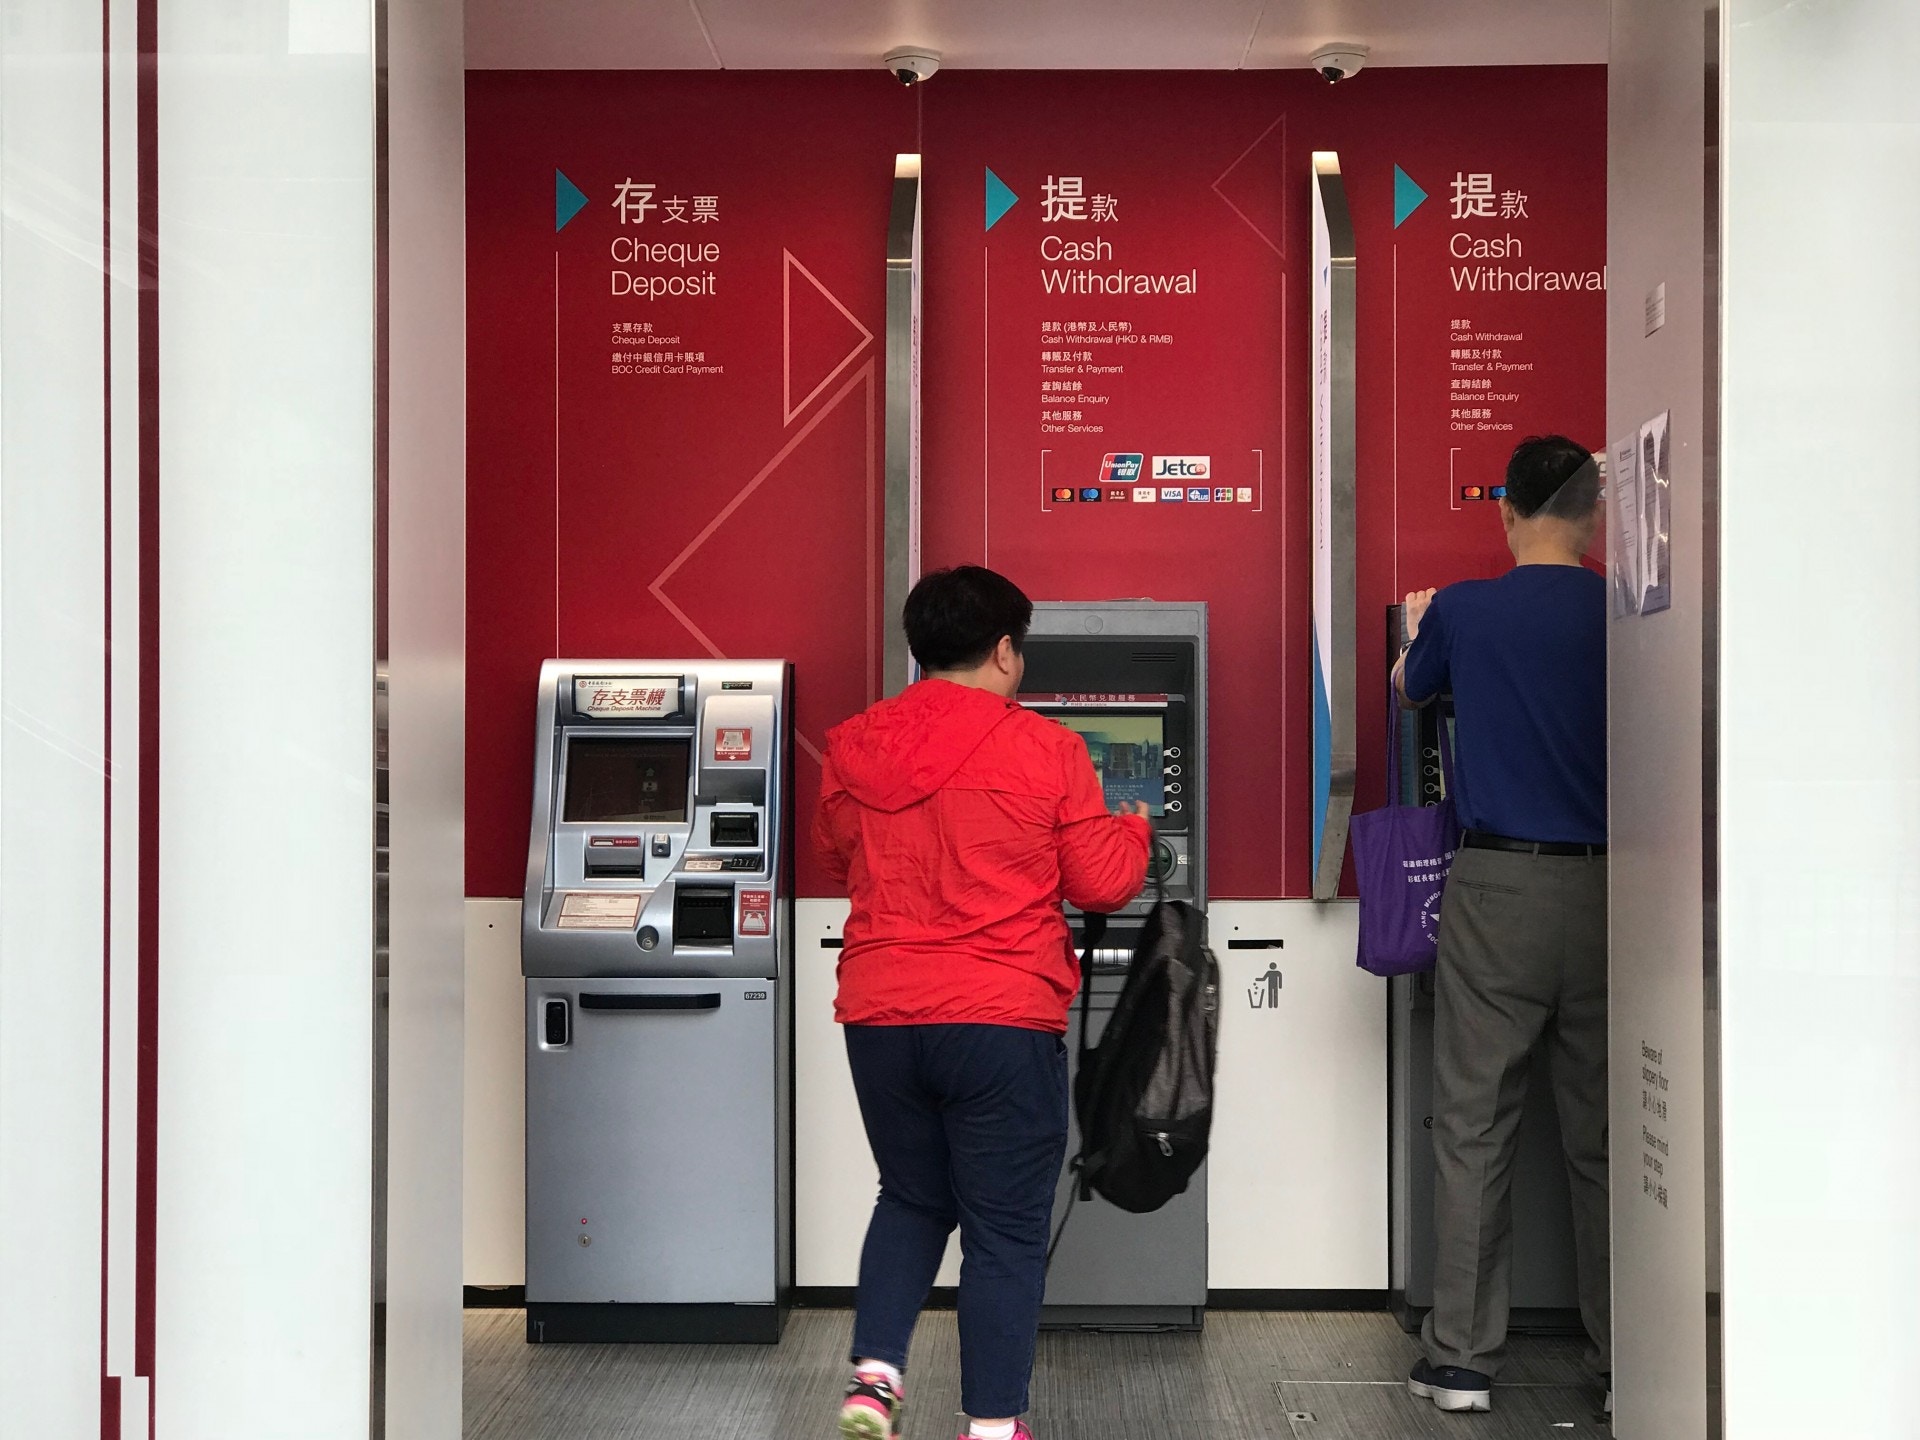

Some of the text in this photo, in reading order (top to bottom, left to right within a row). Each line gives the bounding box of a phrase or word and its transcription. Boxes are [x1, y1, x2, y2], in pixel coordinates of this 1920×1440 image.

[611, 177, 720, 224] 存支票
[1041, 175, 1118, 222] 提款
[1450, 172, 1528, 219] 提款
[1041, 236, 1111, 261] Cash
[1450, 233, 1521, 258] Cash
[611, 237, 719, 267] Cheque
[1041, 269, 1196, 294] Withdrawal
[1450, 266, 1606, 291] Withdrawal
[612, 271, 716, 301] Deposit
[613, 323, 653, 333] 支票存款
[1042, 322, 1061, 331] 提款
[1451, 319, 1470, 329] 提款
[612, 336, 680, 345] Cheque Deposit
[1042, 335, 1173, 344] Cash Withdrawal (HKD & RMB)
[1451, 333, 1522, 341] Cash Withdrawal
[612, 365, 723, 375] BOC Credit Card Payment
[1041, 365, 1123, 374] Transfer & Payment
[1451, 363, 1484, 371] Transfer
[1496, 363, 1533, 372] Payment
[1078, 394, 1109, 404] Enquiry
[1488, 392, 1519, 402] Enquiry
[1042, 411, 1082, 420] 其他服務
[1451, 409, 1491, 418] 其他服務
[1042, 424, 1103, 432] Other Services
[1451, 422, 1513, 430] Other Services
[1105, 461, 1139, 471] UnionPay
[1156, 459, 1207, 476] Jetco
[1163, 490, 1182, 498] VISA
[591, 688, 667, 705] 存支票機
